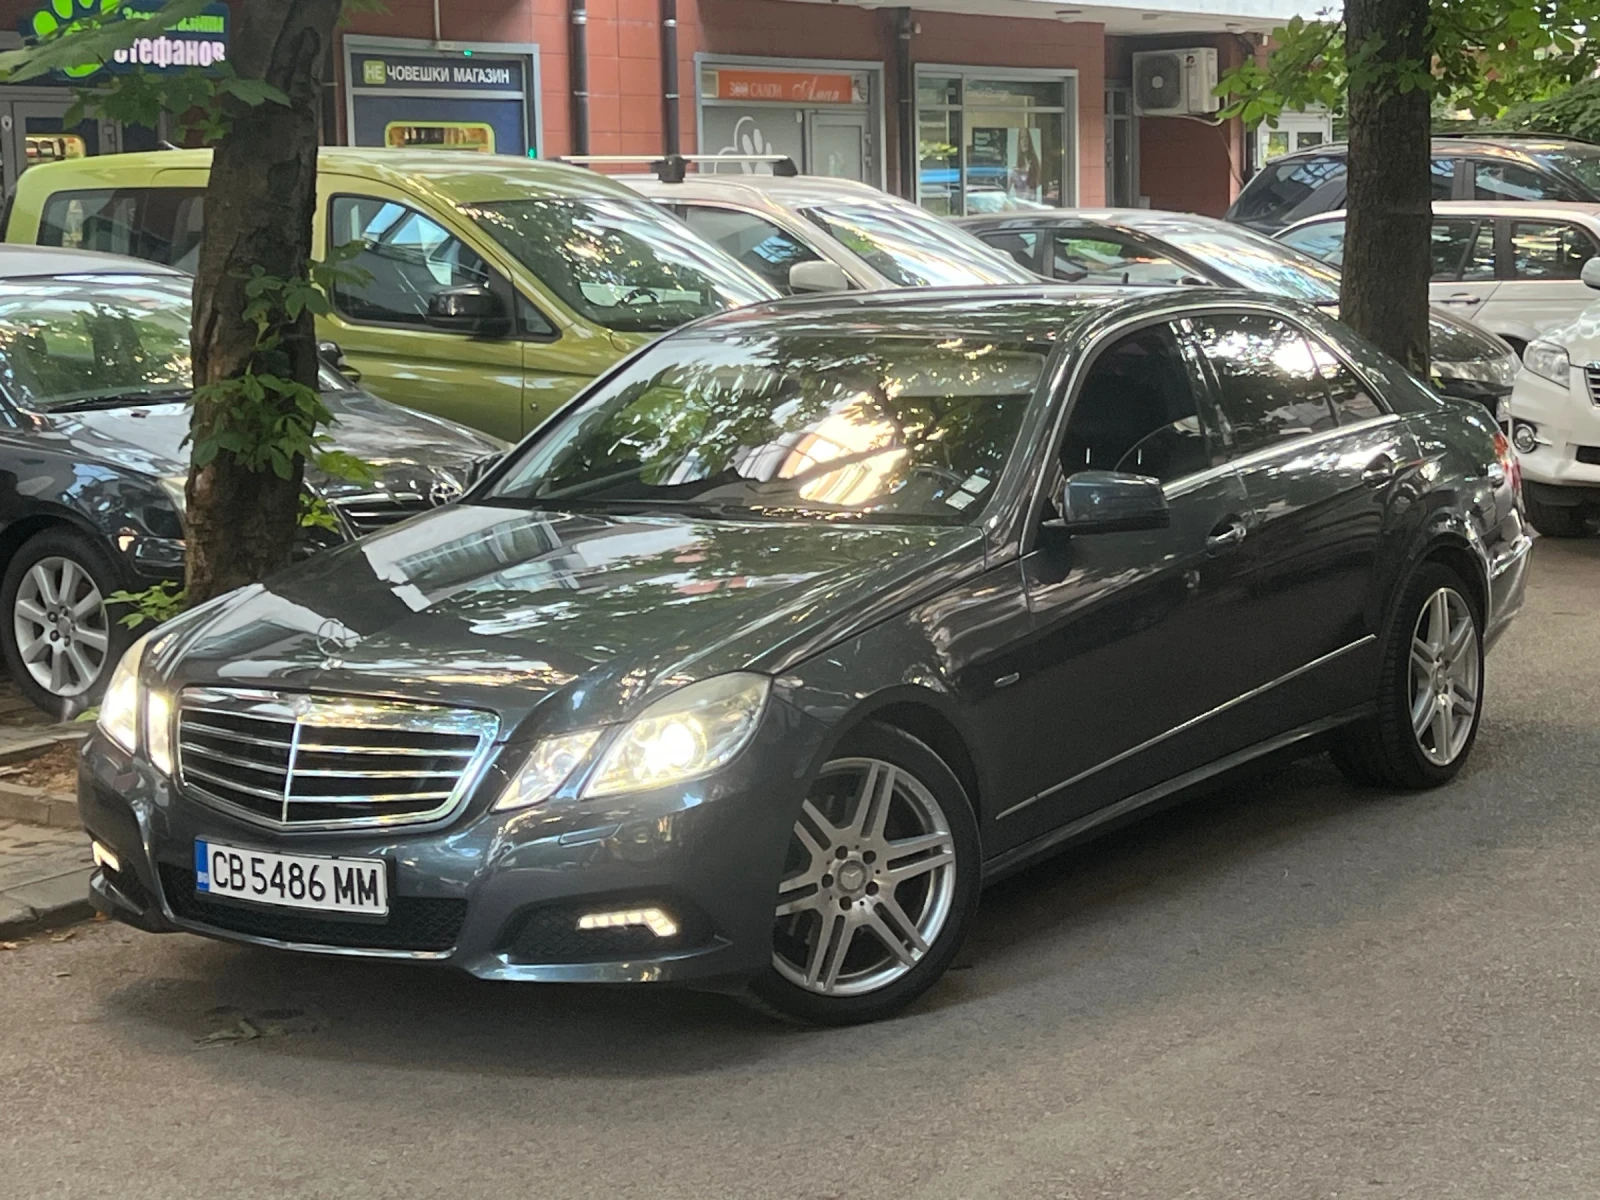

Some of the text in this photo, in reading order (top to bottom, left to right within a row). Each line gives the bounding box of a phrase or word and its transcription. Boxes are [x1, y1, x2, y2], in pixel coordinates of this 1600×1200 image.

[364, 64, 510, 84] НЕ ЧОВЕШКИ МАГАЗИН
[250, 857, 326, 902] 5486
[333, 866, 379, 907] MM
